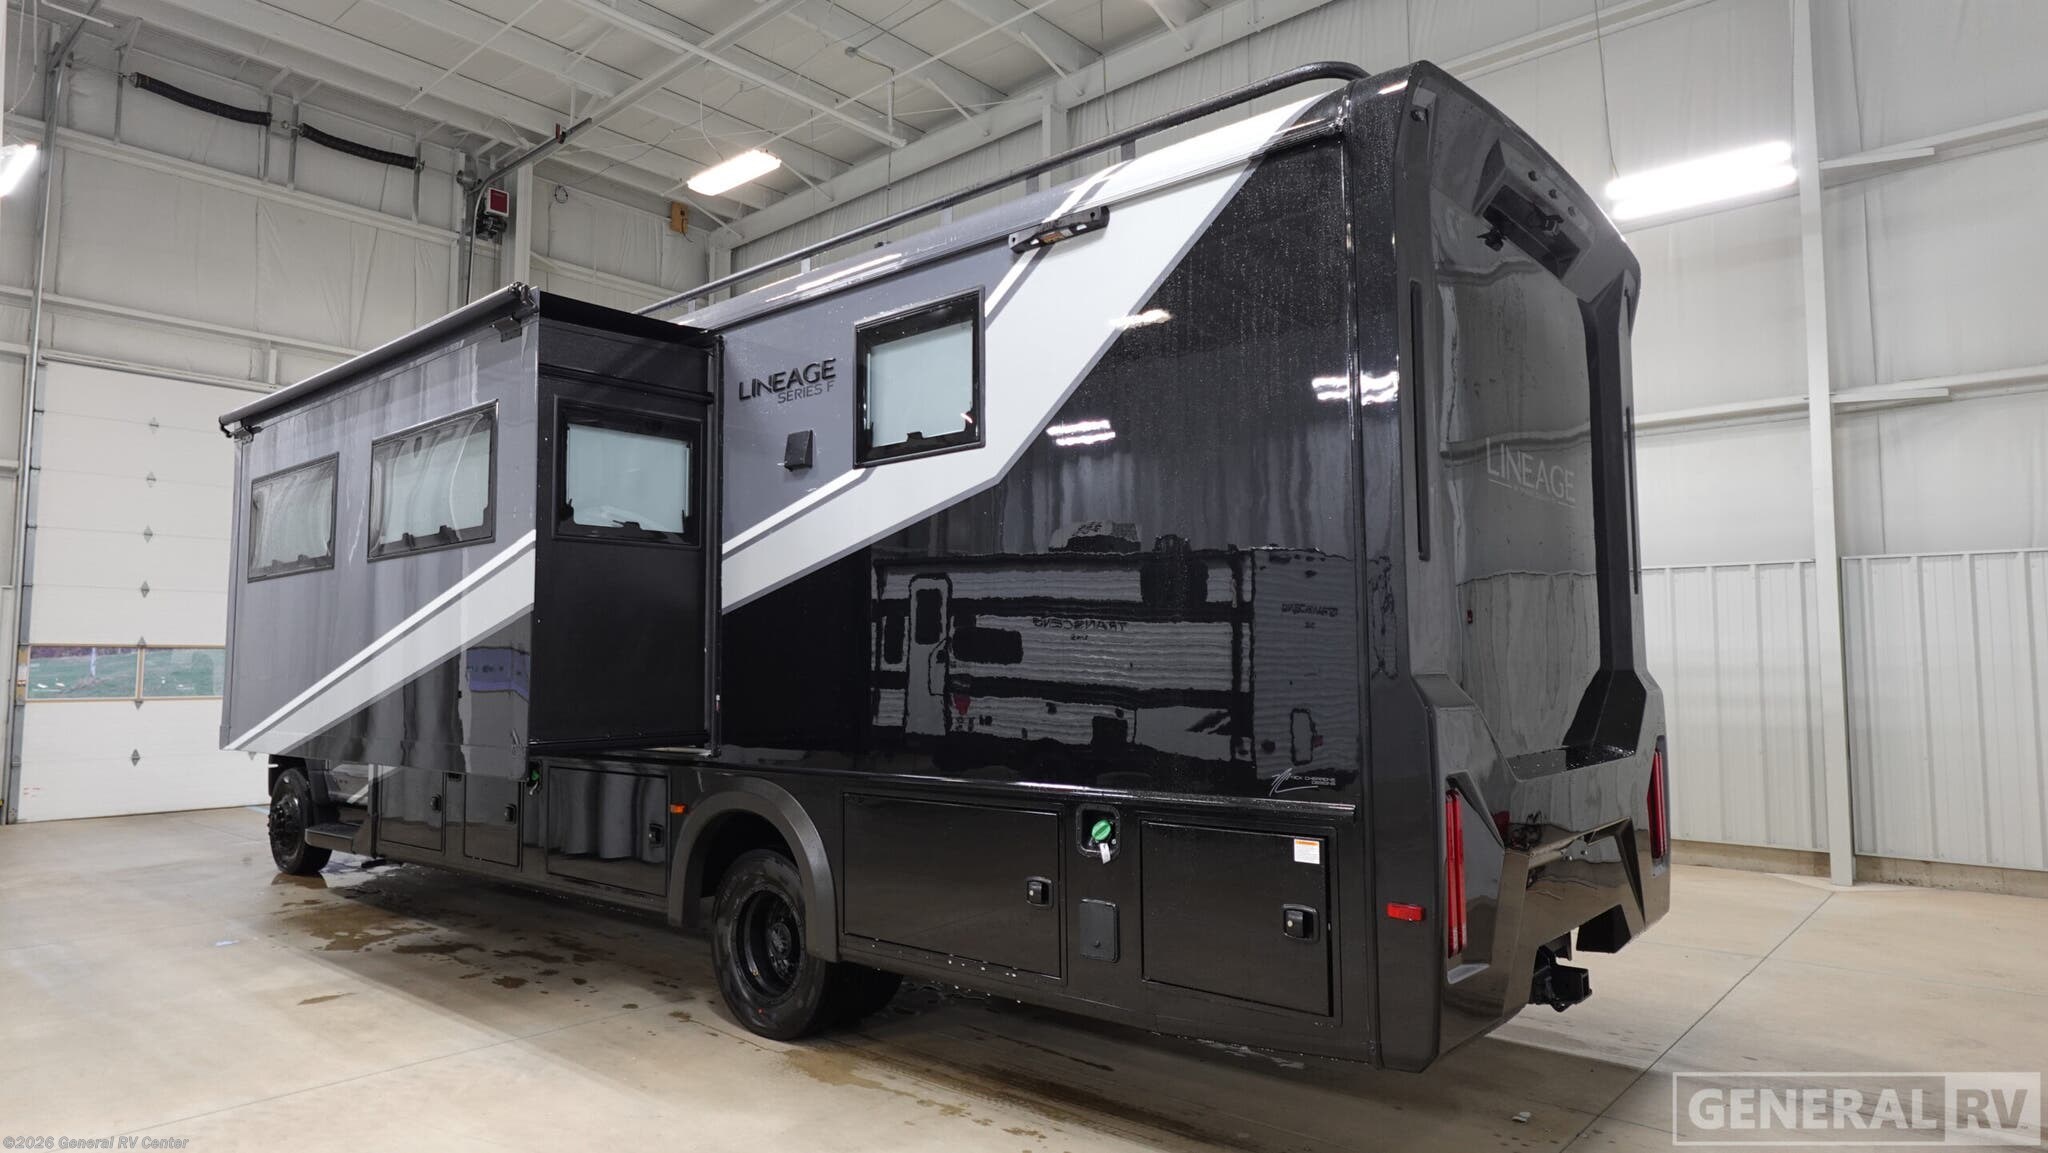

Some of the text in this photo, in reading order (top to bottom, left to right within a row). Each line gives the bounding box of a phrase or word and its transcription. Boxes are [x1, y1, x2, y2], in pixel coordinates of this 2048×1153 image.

[739, 358, 836, 402] LINEAGE
[778, 380, 835, 404] SERIES F
[1486, 437, 1575, 503] LINEAGE
